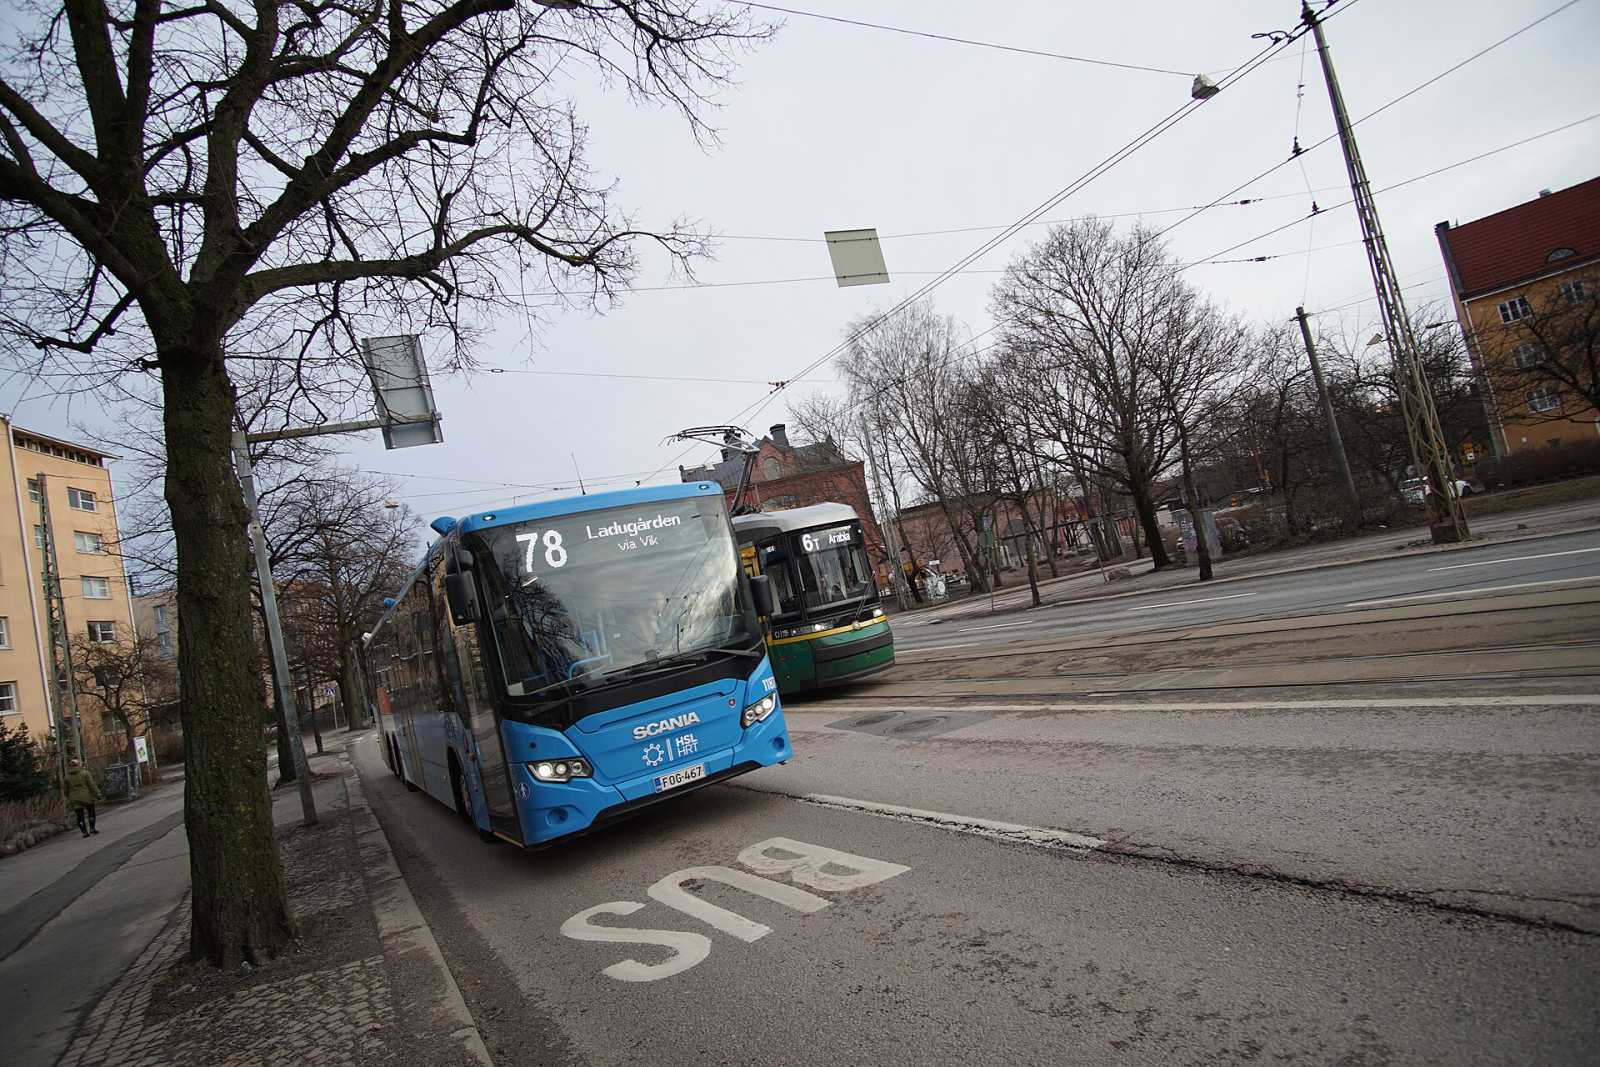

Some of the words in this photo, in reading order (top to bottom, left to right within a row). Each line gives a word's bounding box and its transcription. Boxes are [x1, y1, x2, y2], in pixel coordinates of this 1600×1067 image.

[515, 530, 568, 573] 78
[586, 513, 681, 540] Ladugården
[618, 540, 637, 551] via
[640, 536, 659, 547] Vik
[802, 533, 820, 552] 6T
[828, 532, 851, 544] Arabia
[633, 711, 700, 739] SCANIA
[675, 733, 698, 747] HSL
[677, 741, 698, 757] HRT
[662, 766, 702, 788] FOG-467
[560, 836, 912, 982] BUS
